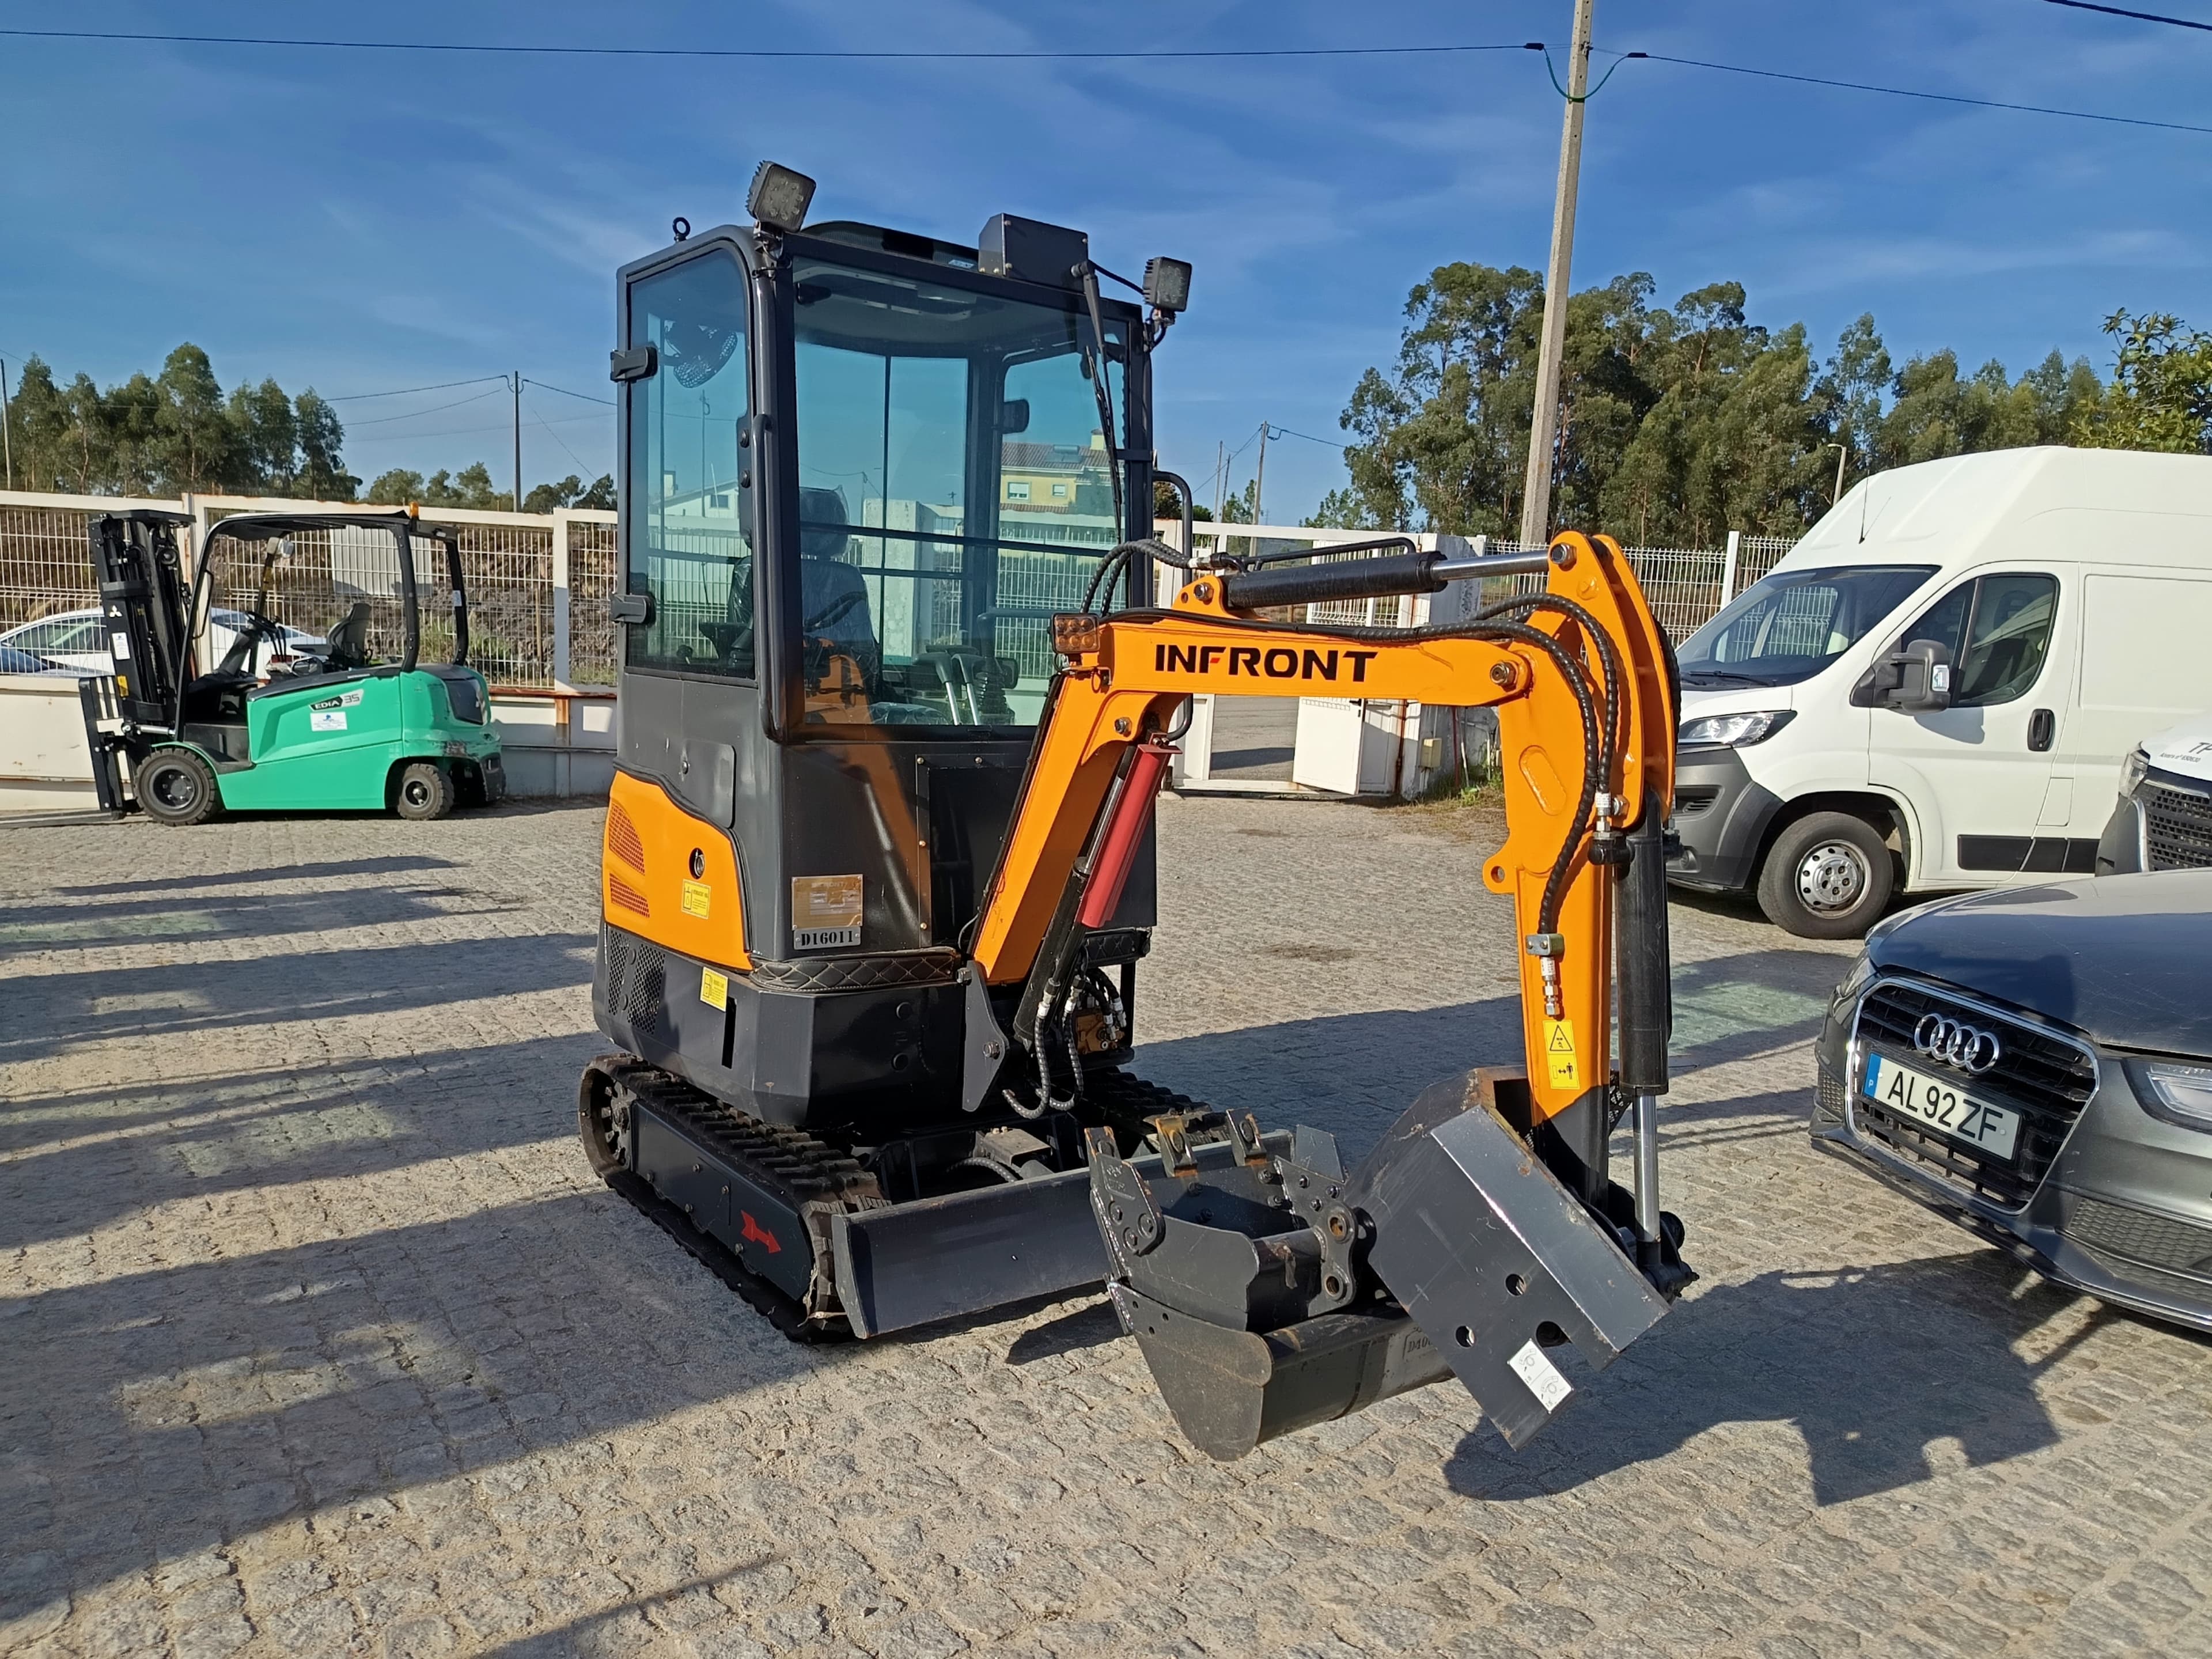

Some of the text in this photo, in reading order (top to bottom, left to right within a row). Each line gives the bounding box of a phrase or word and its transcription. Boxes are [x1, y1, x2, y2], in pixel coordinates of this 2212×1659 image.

[1155, 644, 1378, 682] INFRONT
[344, 693, 360, 704] 35
[801, 930, 853, 946] D16011
[1868, 1079, 1874, 1088] P
[1887, 1071, 2003, 1142] AL 92 ZF
